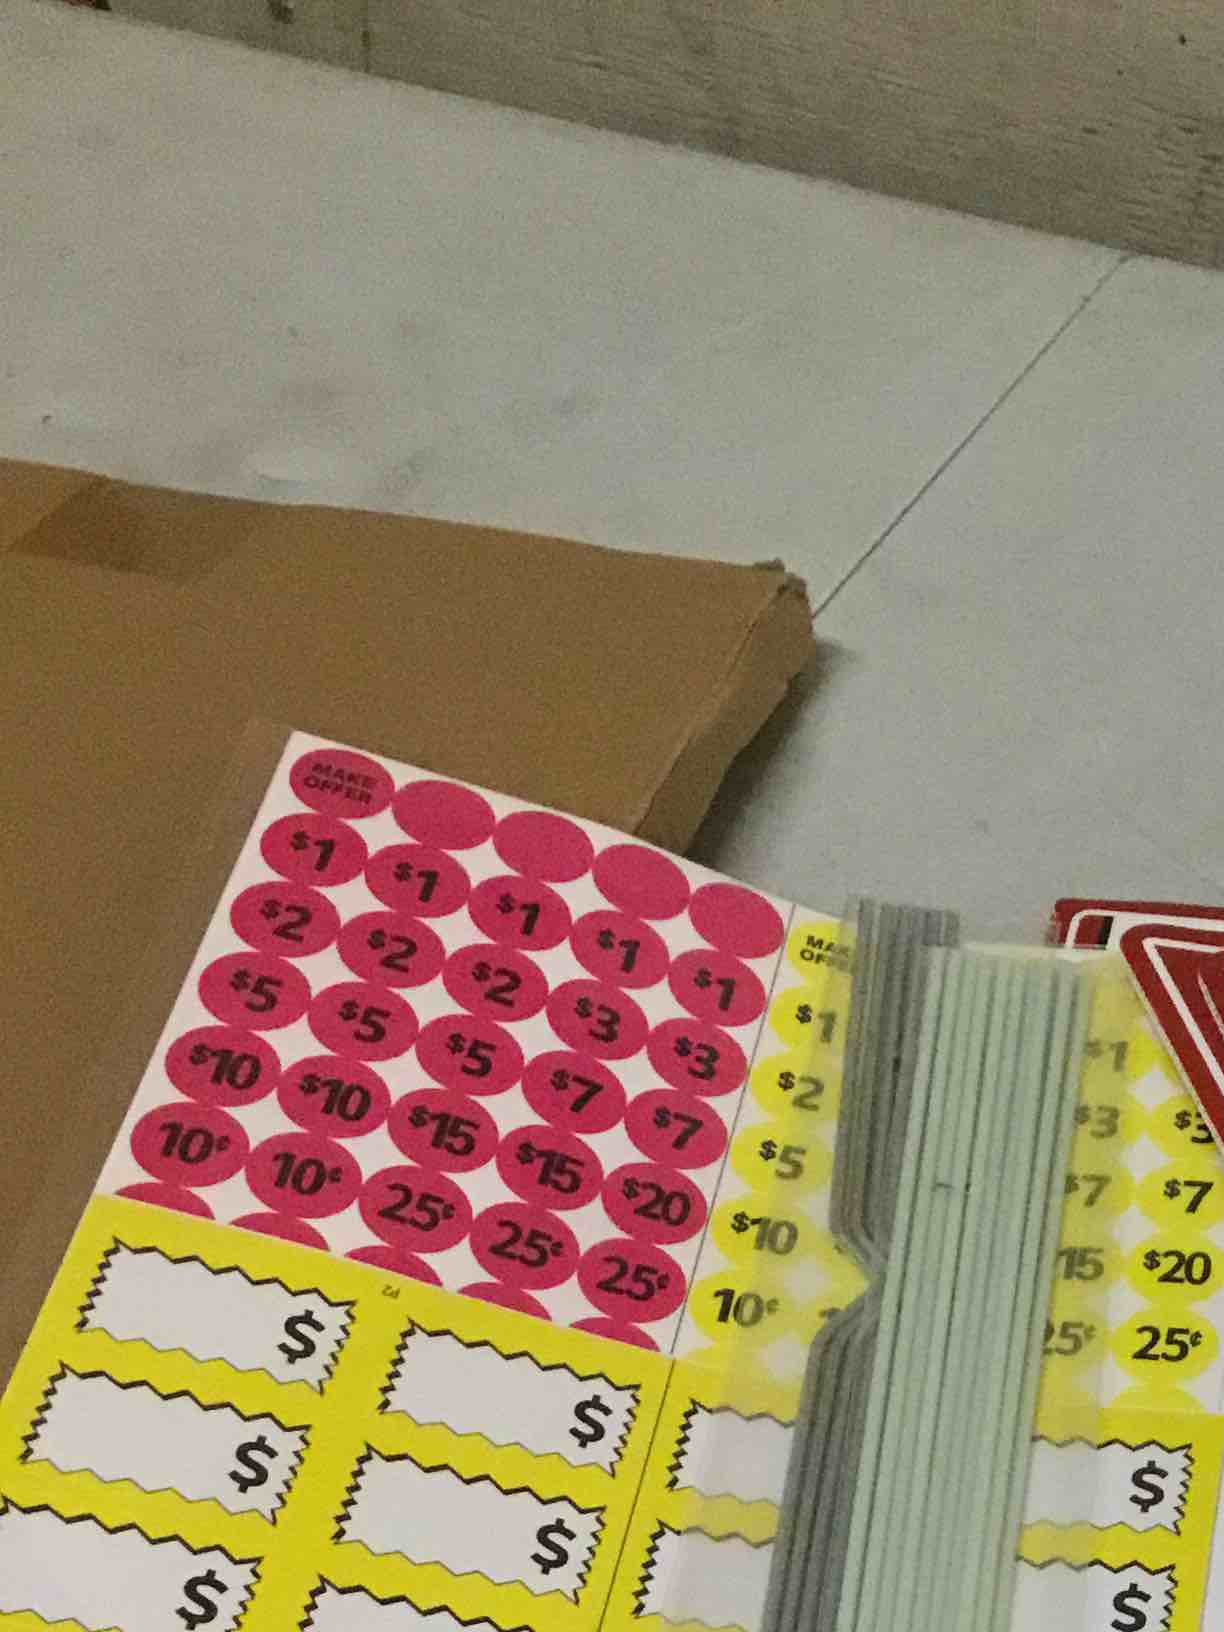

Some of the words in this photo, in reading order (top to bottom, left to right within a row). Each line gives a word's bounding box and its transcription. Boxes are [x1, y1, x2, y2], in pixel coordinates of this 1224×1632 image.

[303, 776, 373, 805] OFFER
[311, 763, 375, 790] MAKE
[291, 831, 336, 872] $1
[394, 862, 439, 903] $1
[261, 899, 312, 943] $2
[497, 894, 541, 937] $1
[367, 929, 417, 973] $2
[597, 929, 641, 973] $1
[230, 969, 282, 1013] $5
[471, 961, 522, 1008] $2
[694, 968, 737, 1011] $1
[338, 1000, 390, 1043] $5
[575, 997, 621, 1043] $3
[796, 1003, 838, 1043] $1
[189, 1043, 262, 1091] $10
[447, 1032, 496, 1078] $5
[674, 1036, 720, 1081] $3
[299, 1073, 372, 1122] $10
[550, 1069, 604, 1114] $7
[778, 1071, 826, 1112] $2
[408, 1105, 480, 1157] $15
[653, 1106, 703, 1150] $7
[516, 1141, 584, 1195] $15
[759, 1139, 807, 1180] $5
[622, 1178, 692, 1227] $20
[1163, 1178, 1215, 1214] $7
[730, 1211, 799, 1255] $10
[1056, 1246, 1105, 1281] 15
[1142, 1249, 1213, 1286] $20
[277, 1309, 326, 1365] $
[568, 1394, 613, 1449] $
[228, 1435, 279, 1494] $
[1129, 1460, 1169, 1514] $
[530, 1517, 577, 1576] $
[175, 1568, 229, 1631] $
